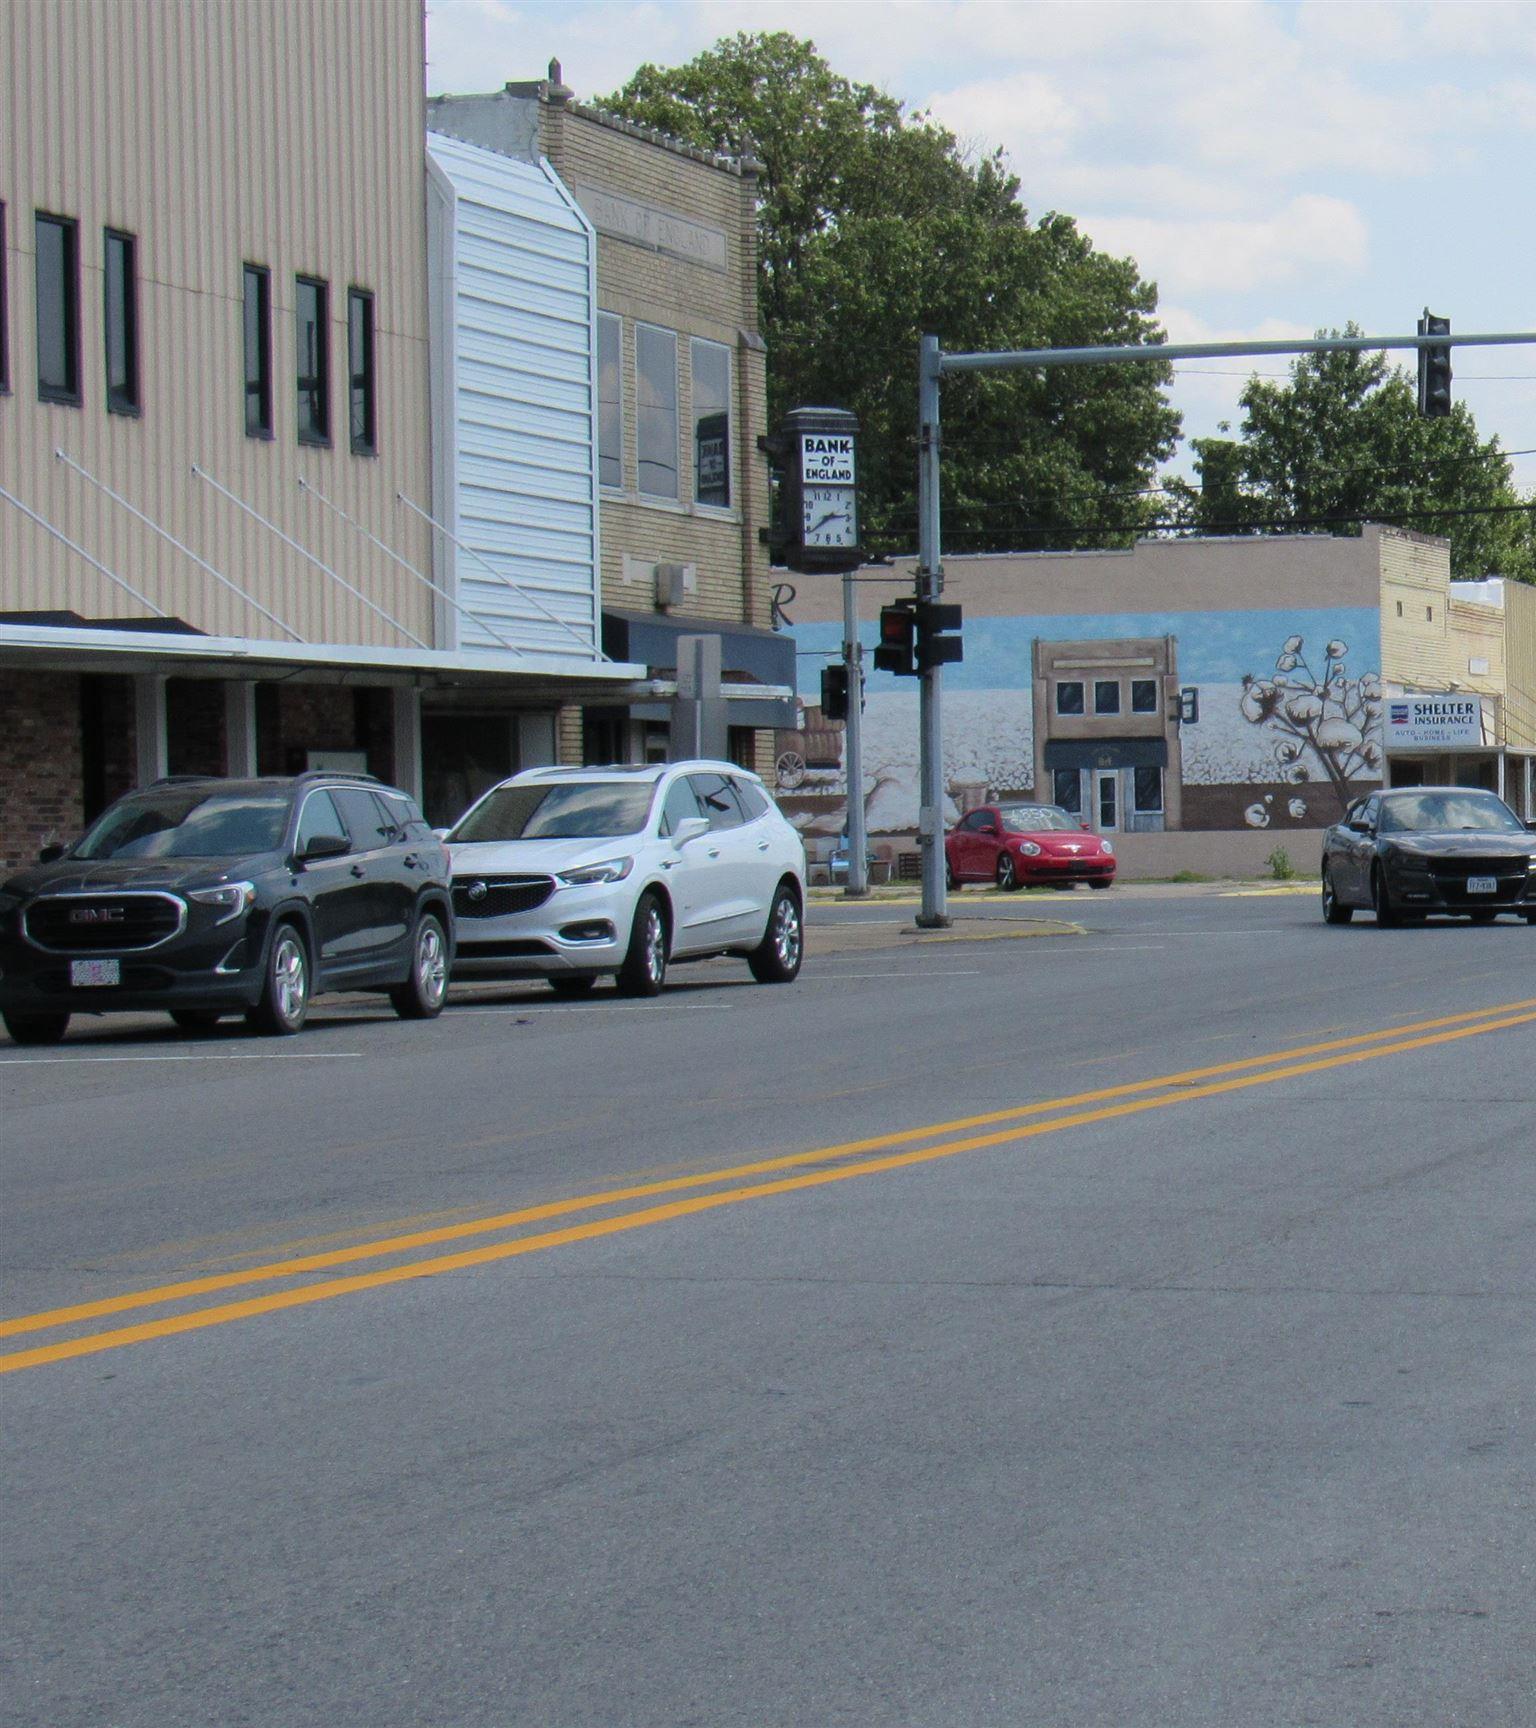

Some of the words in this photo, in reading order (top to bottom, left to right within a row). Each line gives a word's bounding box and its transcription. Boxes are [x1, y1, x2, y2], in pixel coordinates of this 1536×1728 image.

[805, 439, 850, 453] BANK
[822, 455, 835, 467] OF
[806, 468, 851, 480] ENGLAND
[824, 493, 832, 501] 12
[804, 501, 813, 510] 10
[1414, 703, 1474, 715] SHELTER
[1414, 716, 1474, 725] INSURANCE
[70, 907, 125, 922] GMC
